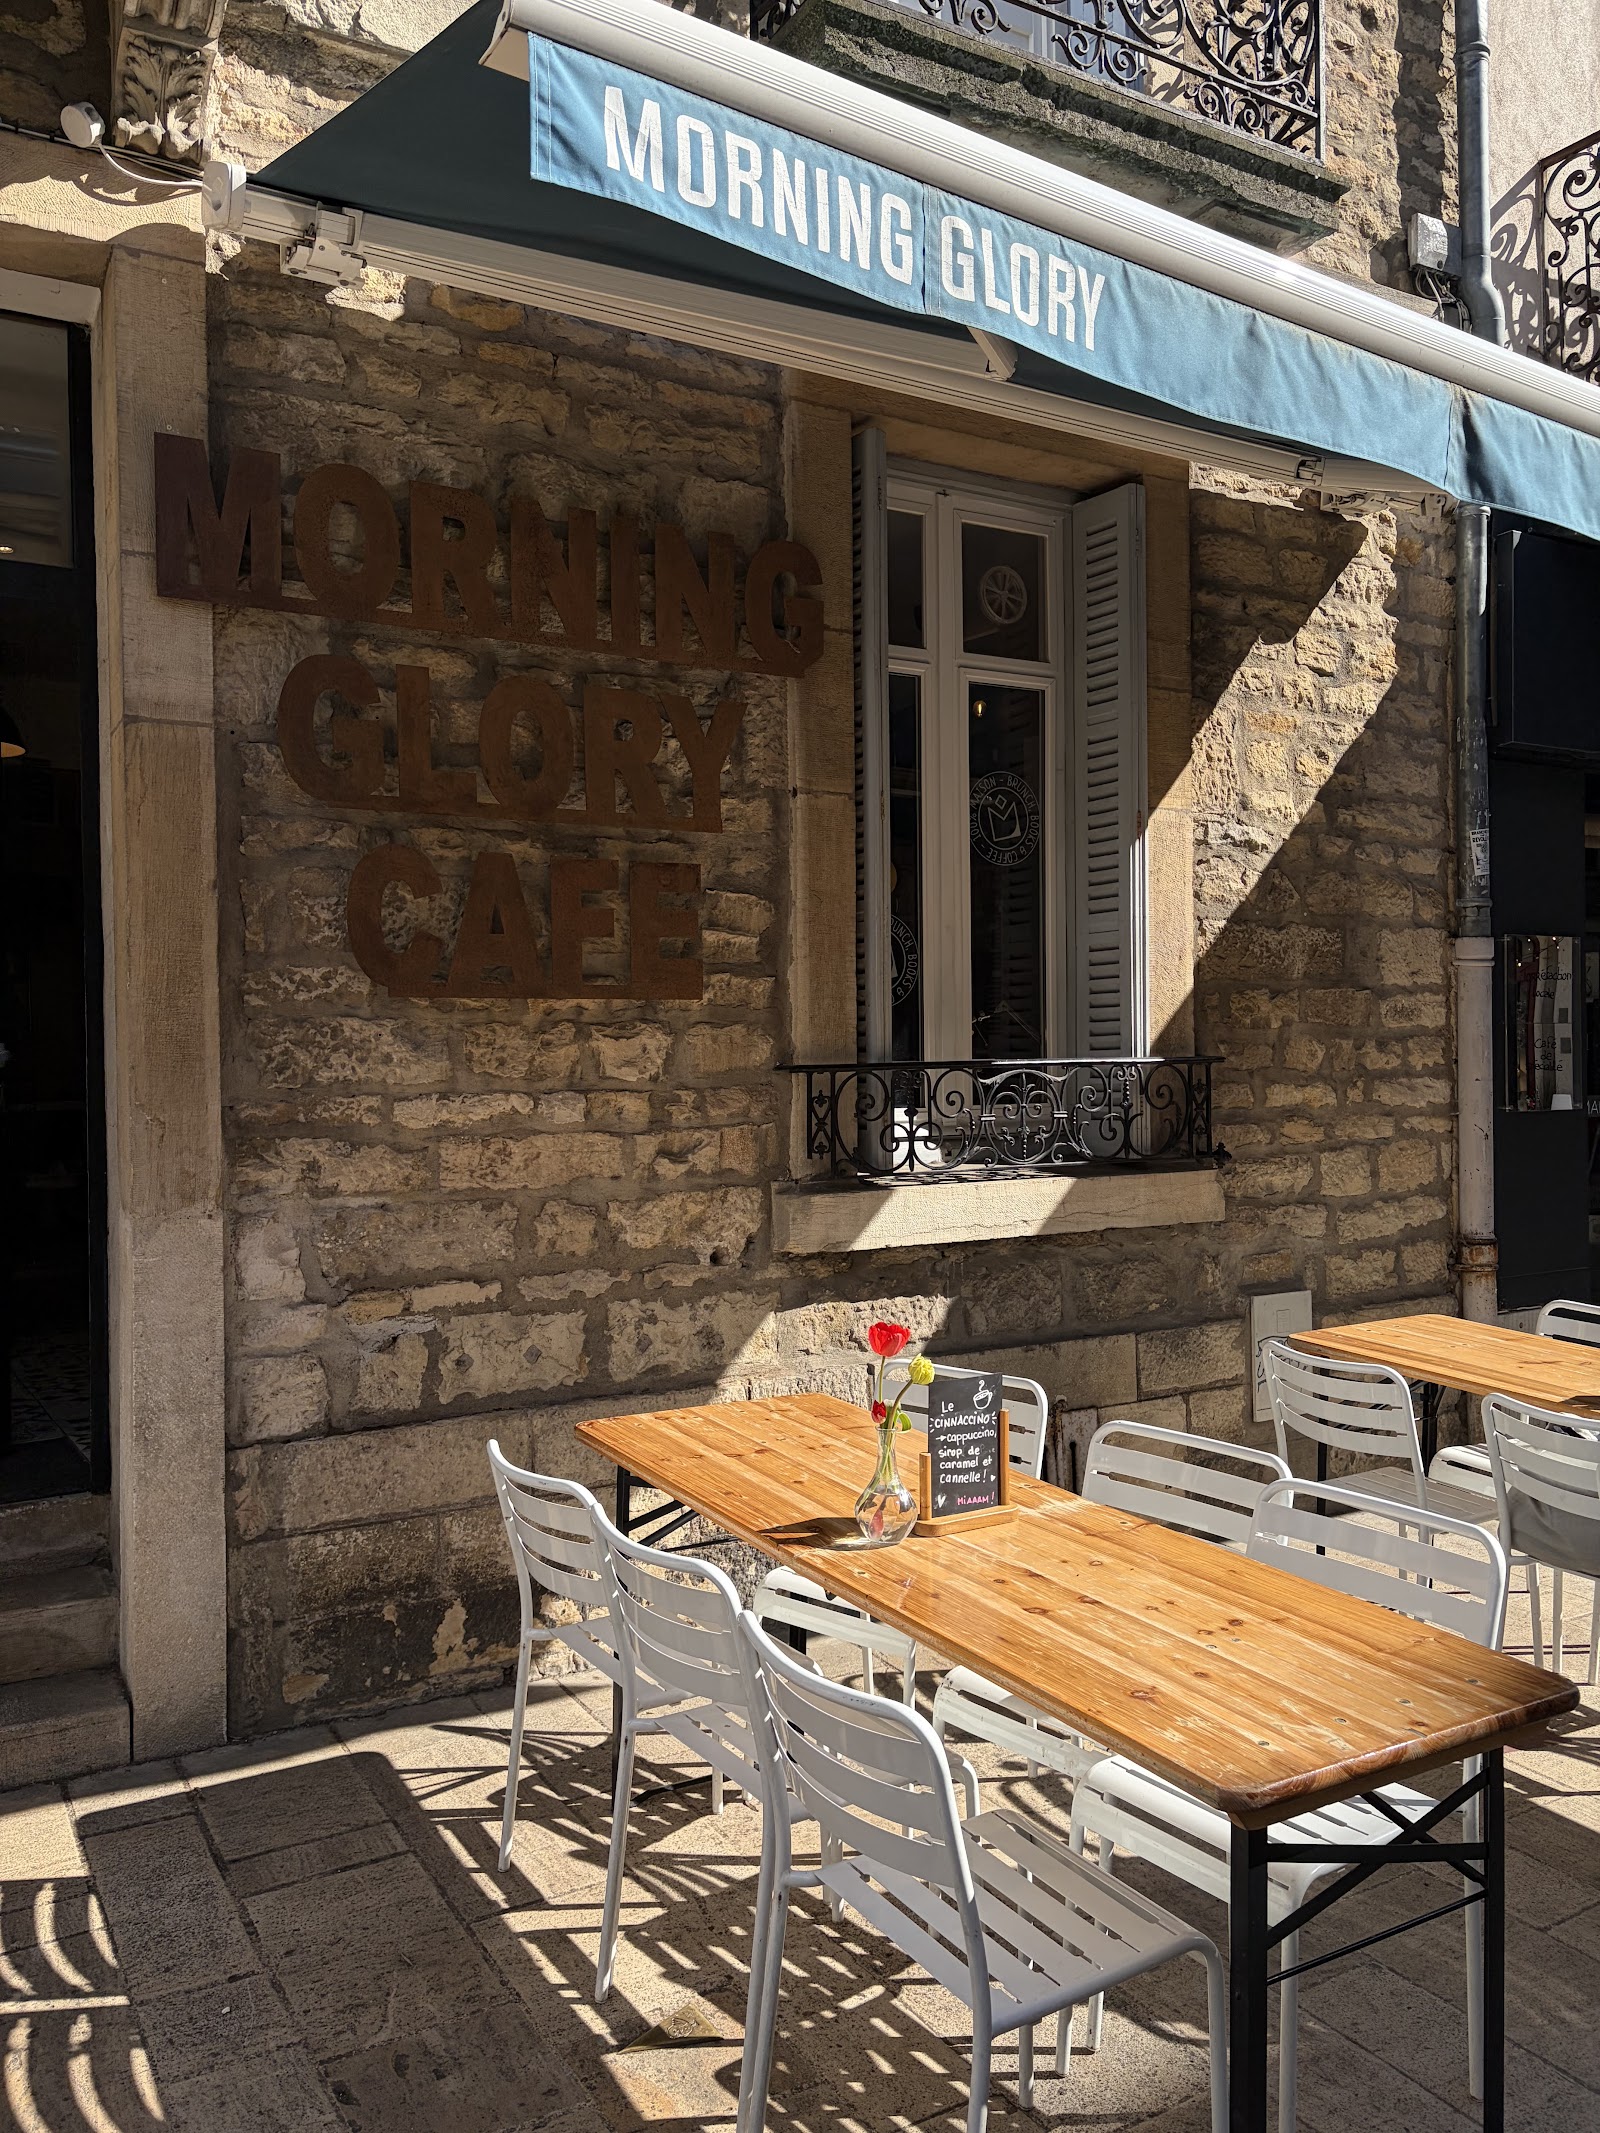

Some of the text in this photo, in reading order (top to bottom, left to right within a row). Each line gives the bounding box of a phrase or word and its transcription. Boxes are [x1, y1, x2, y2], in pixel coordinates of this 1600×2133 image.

[603, 86, 1106, 352] MORNING GLORY
[154, 432, 826, 678] MORNING
[277, 653, 749, 834] GLORY
[970, 775, 997, 810] MAISON
[969, 812, 982, 842] 100%
[1025, 815, 1040, 848] BOOKS
[986, 847, 1018, 863] COFFEE
[1019, 845, 1027, 855] &
[346, 843, 703, 1001] CAFE
[902, 953, 918, 989] BOOKS
[1534, 1036, 1557, 1049] Café
[1541, 1050, 1552, 1060] de
[942, 1401, 954, 1413] Le
[938, 1445, 980, 1459] sirop de
[940, 1455, 993, 1469] caramel et
